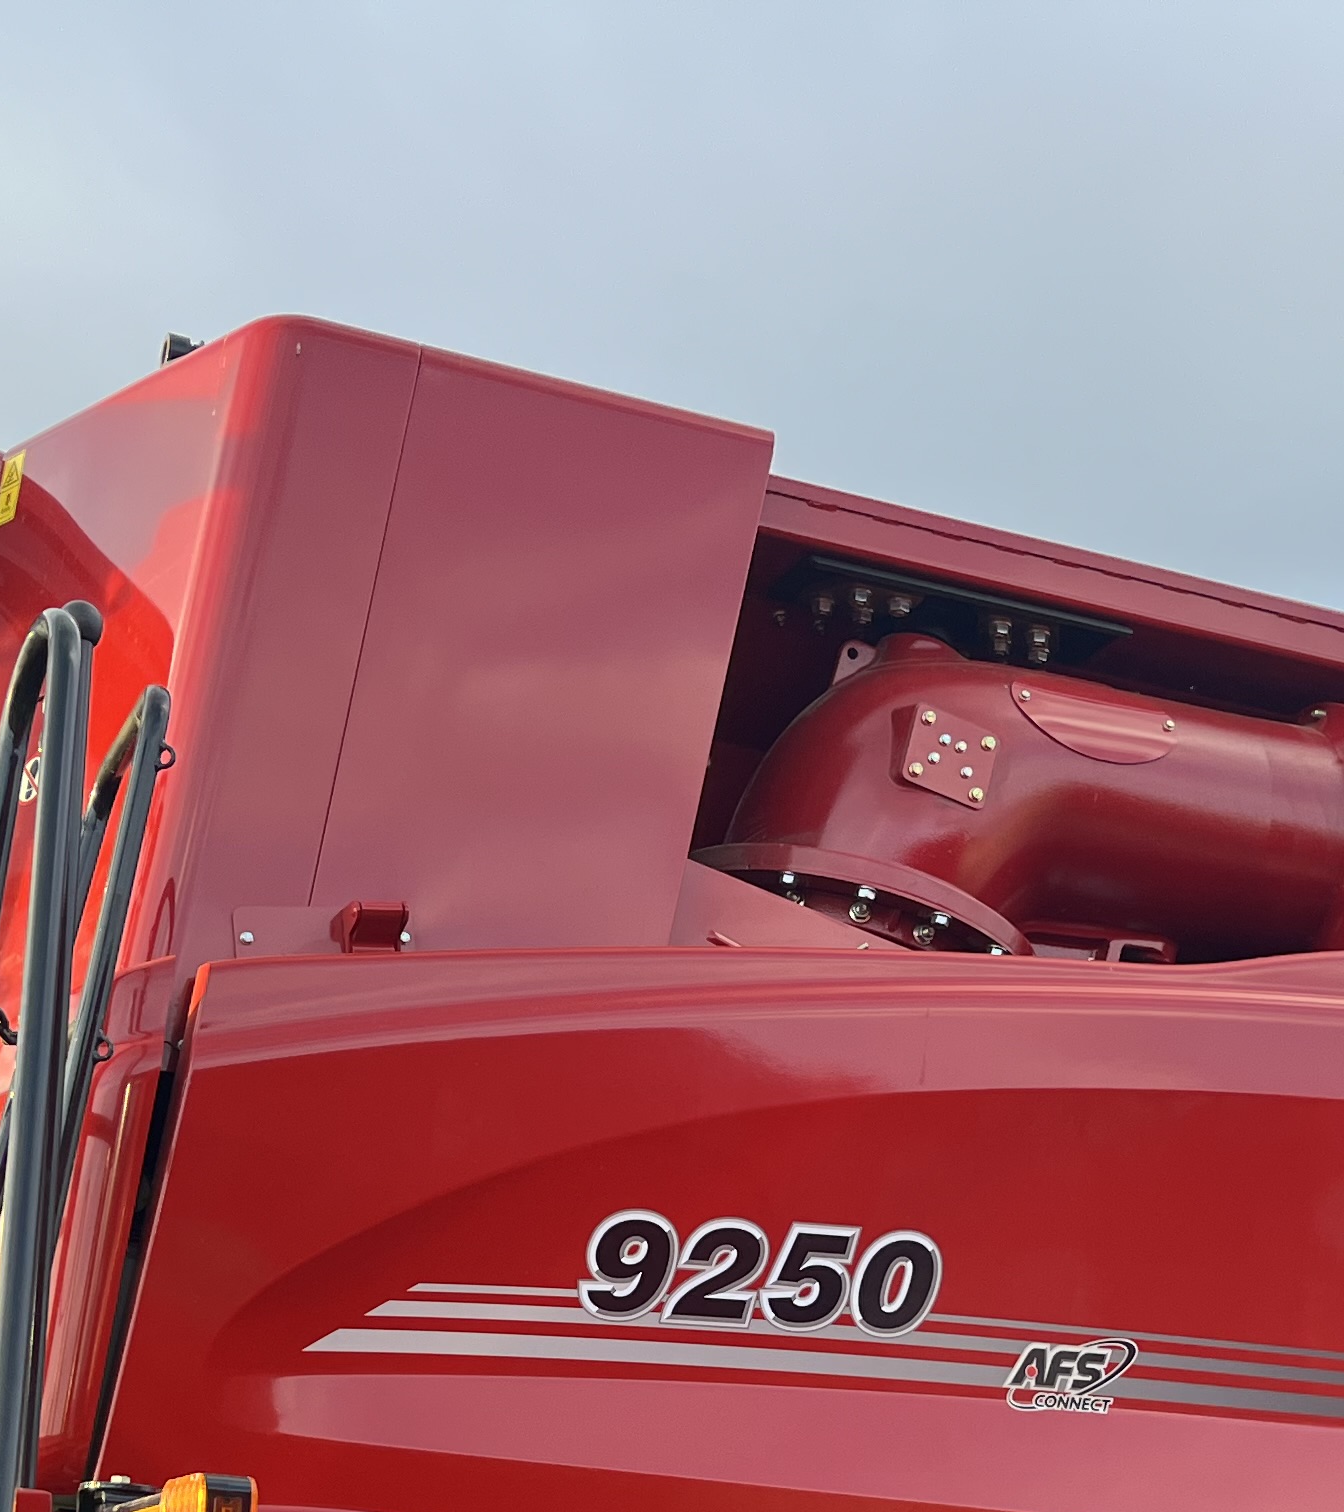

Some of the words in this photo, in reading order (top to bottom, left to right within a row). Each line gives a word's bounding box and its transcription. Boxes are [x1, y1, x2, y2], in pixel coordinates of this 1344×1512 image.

[578, 1209, 942, 1337] 9250
[1006, 1344, 1110, 1391] AFS
[1033, 1393, 1112, 1413] CONNECT
